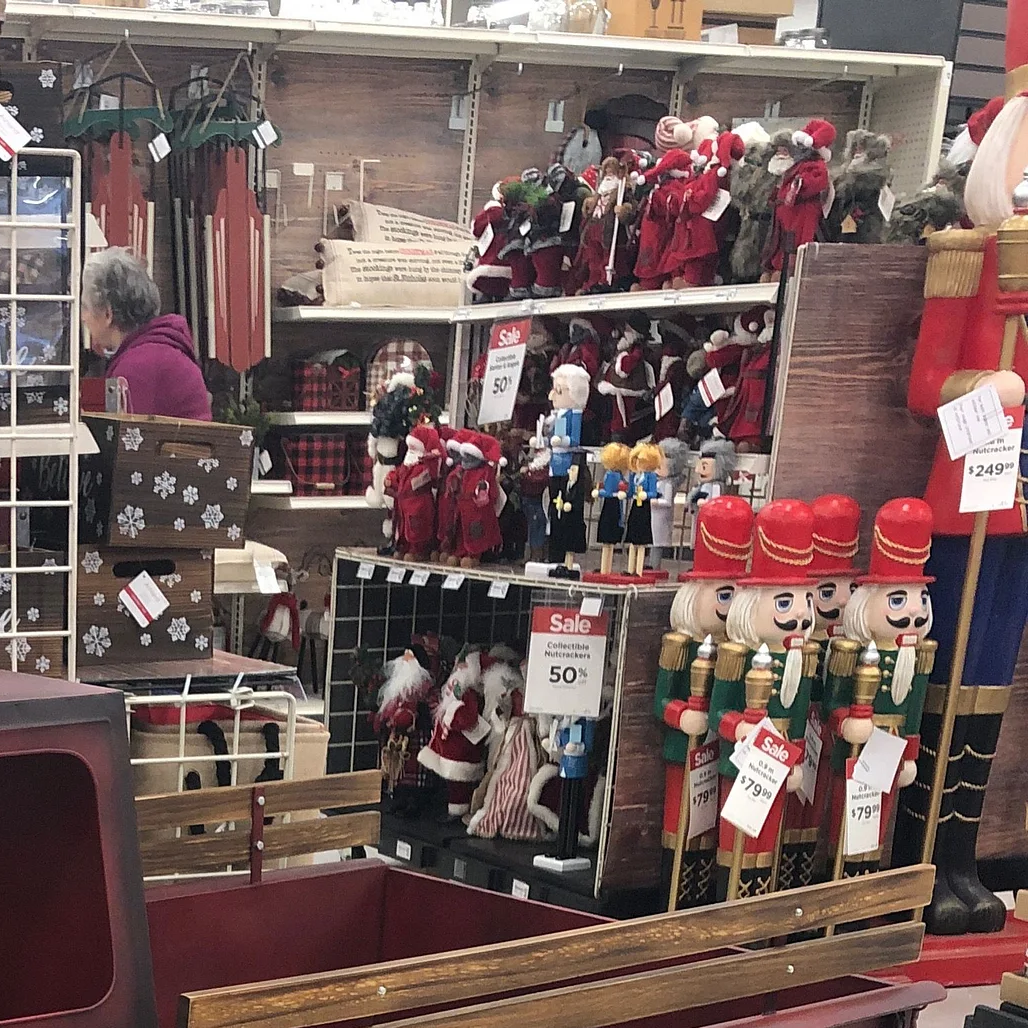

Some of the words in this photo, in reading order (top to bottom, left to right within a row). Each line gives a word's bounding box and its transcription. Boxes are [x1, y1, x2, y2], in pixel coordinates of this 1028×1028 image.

[498, 326, 521, 347] Sale
[972, 444, 1015, 455] Nutcracker
[549, 613, 591, 634] Sale
[544, 650, 591, 660] Nutcrackers
[547, 641, 590, 651] Collectible
[694, 748, 715, 766] Sale
[761, 736, 789, 762] Sale
[748, 762, 778, 785] Nutcracker
